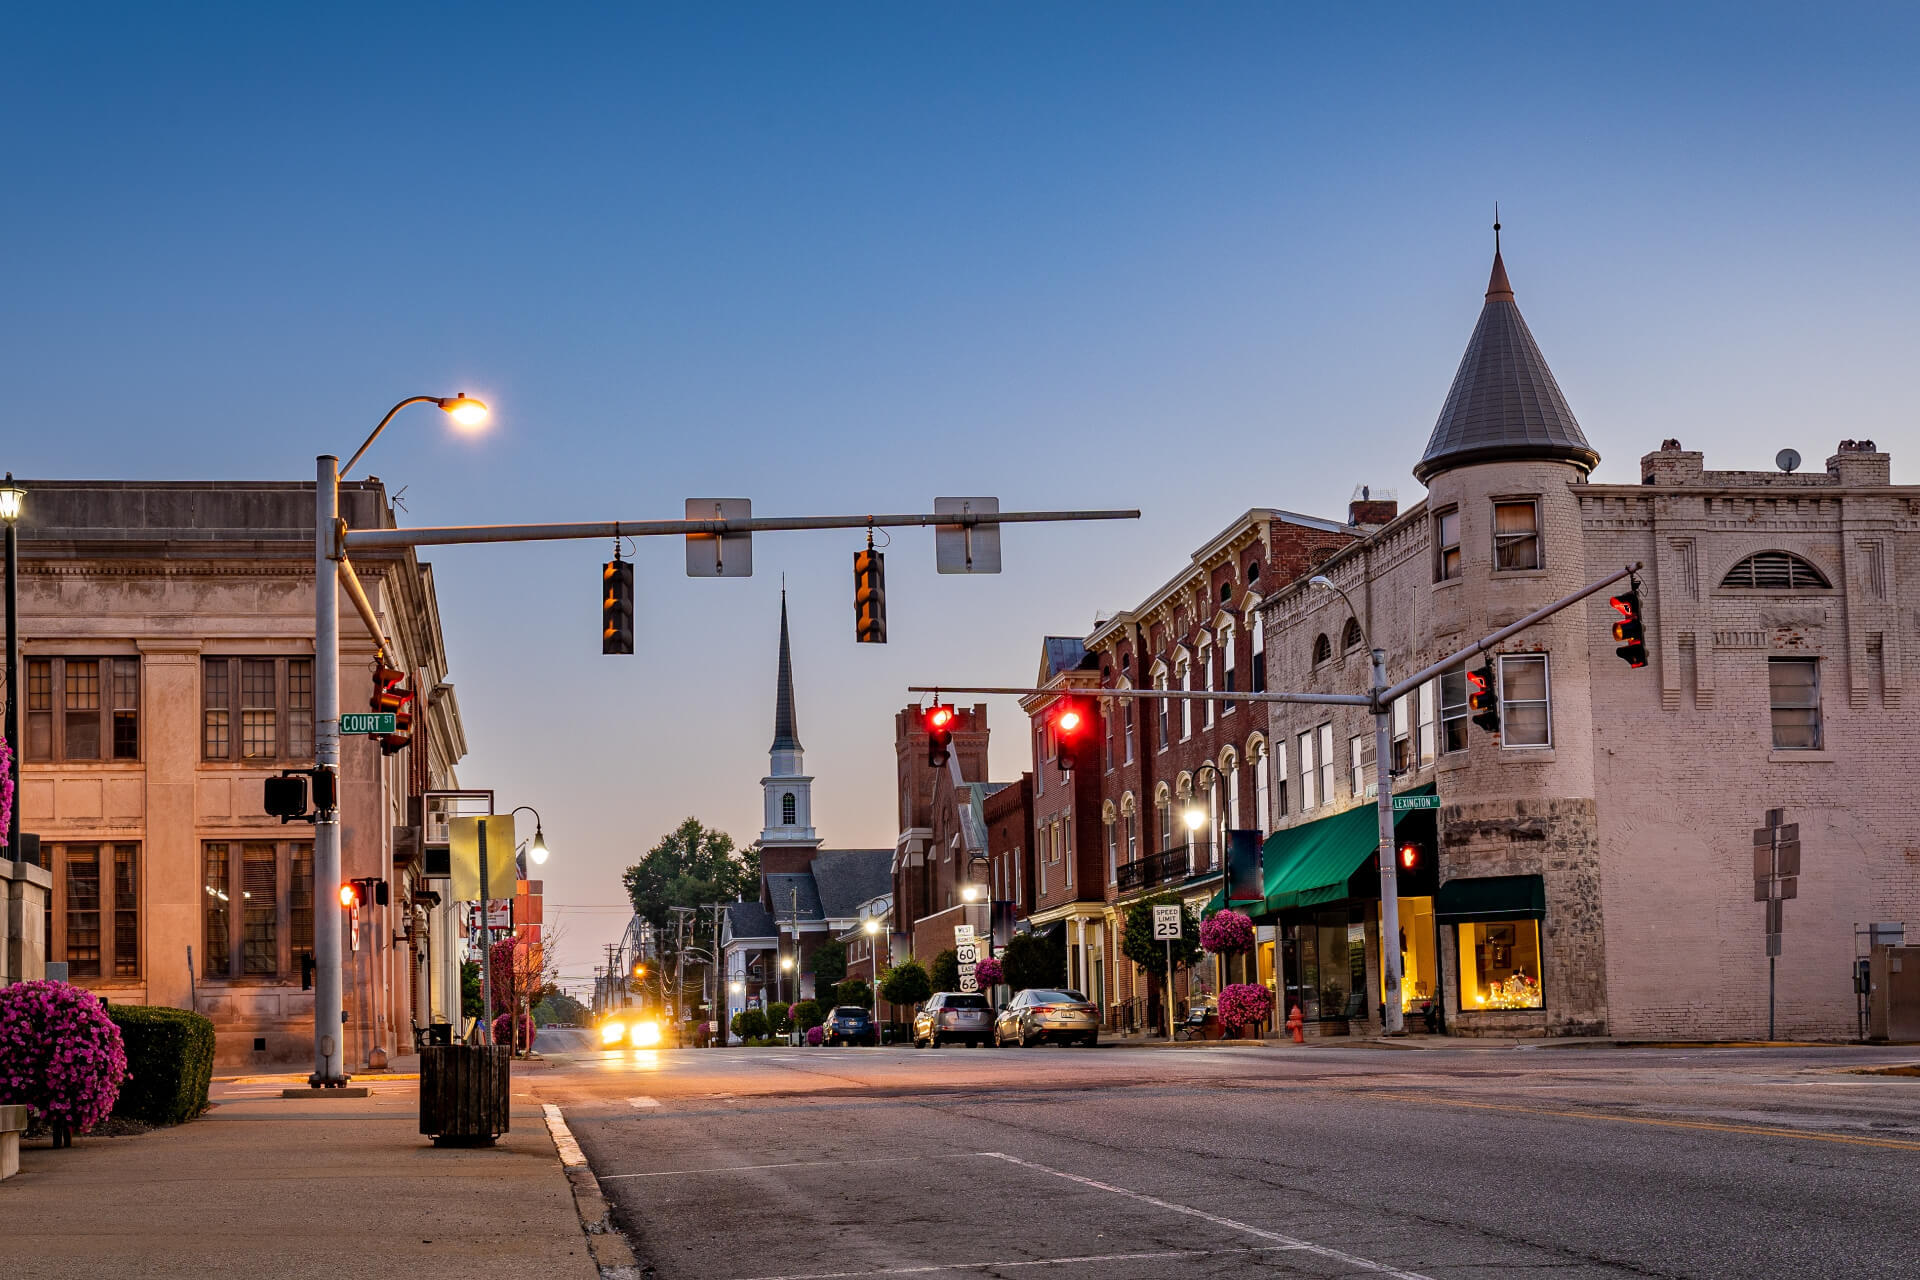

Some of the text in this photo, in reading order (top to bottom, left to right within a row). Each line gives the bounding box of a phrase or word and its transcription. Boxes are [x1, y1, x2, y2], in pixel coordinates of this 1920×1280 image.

[344, 716, 380, 731] COURT
[1394, 798, 1430, 808] LEXINGTON
[1158, 923, 1178, 935] 25
[960, 949, 973, 960] 60
[962, 979, 976, 989] 62
